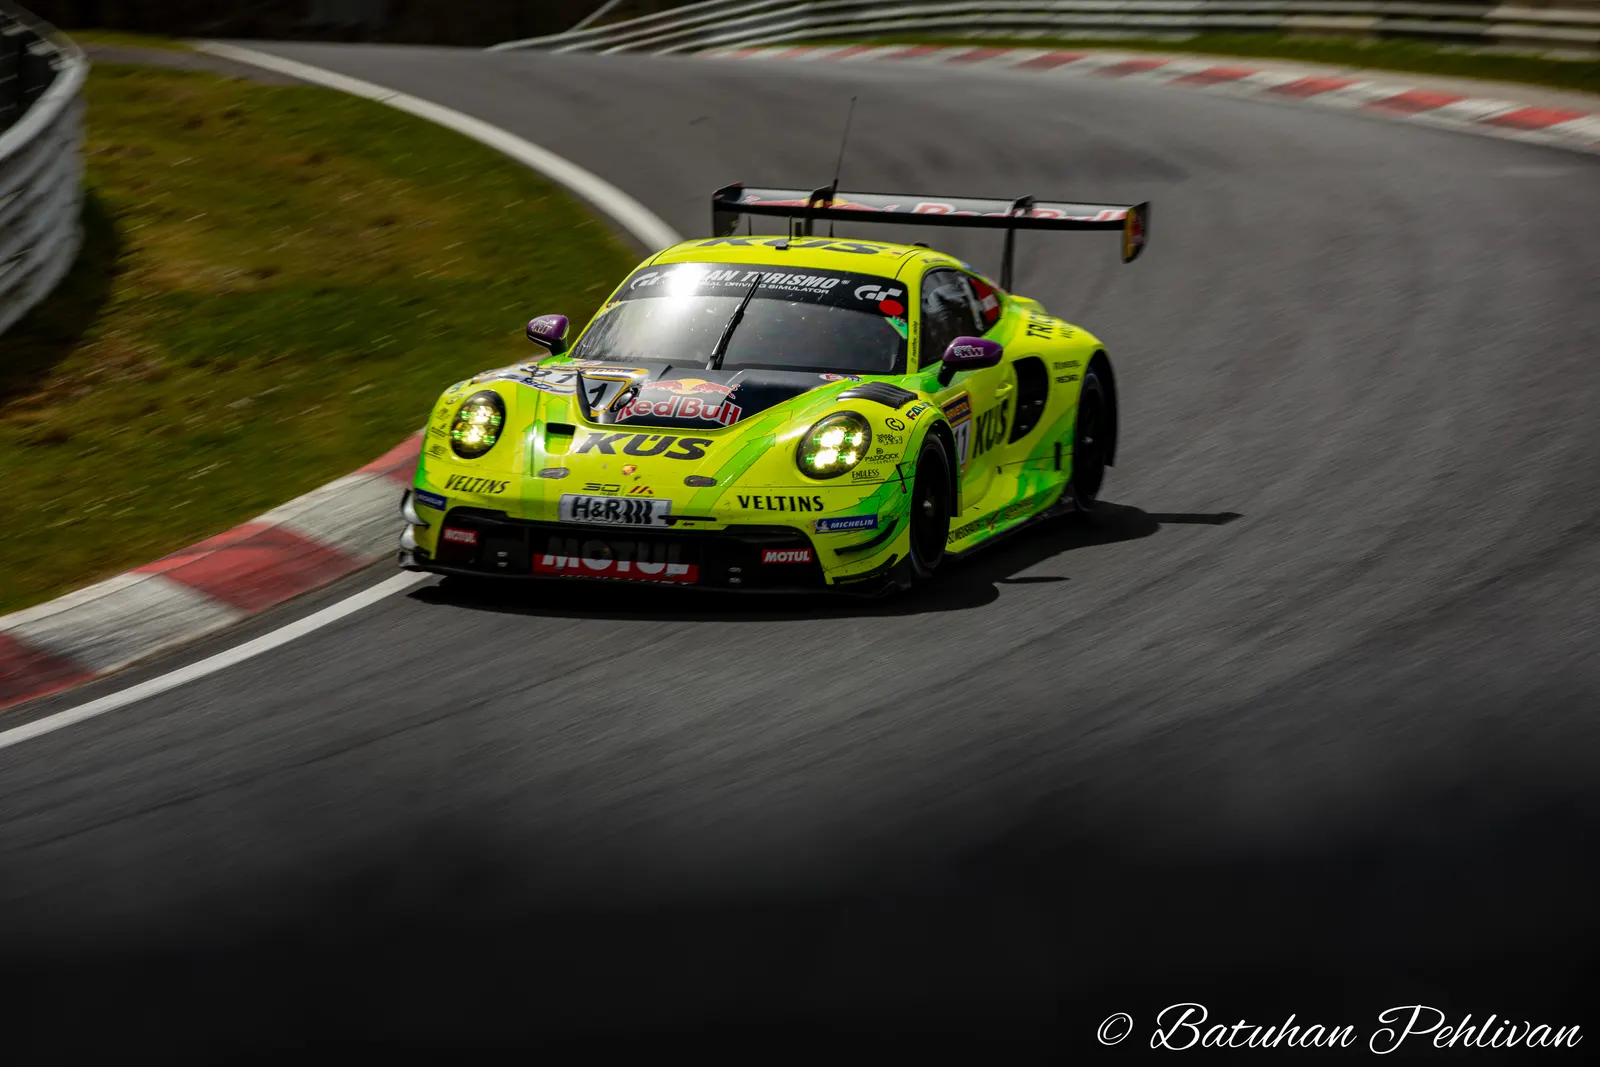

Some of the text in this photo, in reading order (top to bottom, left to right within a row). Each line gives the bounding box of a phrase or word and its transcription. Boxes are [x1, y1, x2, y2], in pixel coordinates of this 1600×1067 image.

[768, 284, 829, 295] SIMULATOR
[616, 396, 743, 426] Red Bull
[576, 431, 713, 460] KÜS
[864, 452, 900, 462] PADDOCK
[851, 468, 880, 479] ENDLESS
[444, 473, 512, 495] VELTINS
[571, 496, 621, 519] H&R
[737, 494, 825, 512] VELTINS
[830, 518, 875, 530] MICHELIN
[541, 536, 690, 575] MOTUL
[763, 550, 811, 563] MOTUL
